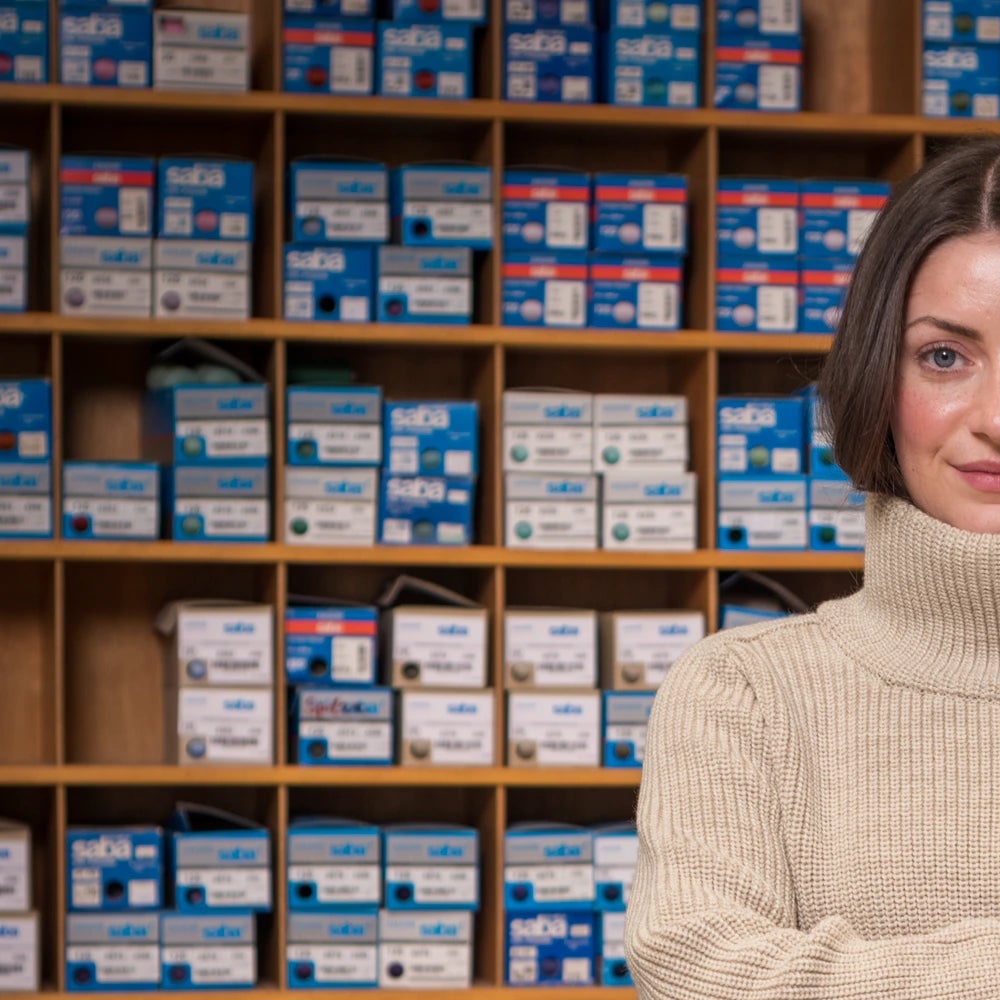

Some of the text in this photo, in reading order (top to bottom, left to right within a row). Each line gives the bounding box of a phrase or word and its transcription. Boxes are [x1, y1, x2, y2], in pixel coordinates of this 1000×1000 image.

[61, 15, 122, 40] saba
[384, 27, 442, 50] saba
[509, 32, 566, 56] saba
[617, 37, 673, 60] saba
[923, 49, 978, 69] saba
[167, 165, 225, 186] saba
[287, 250, 345, 271] saba
[391, 405, 449, 431] saba
[720, 404, 776, 429] saba
[388, 478, 446, 502] saba
[73, 837, 132, 862] saba
[511, 916, 568, 941] saba
